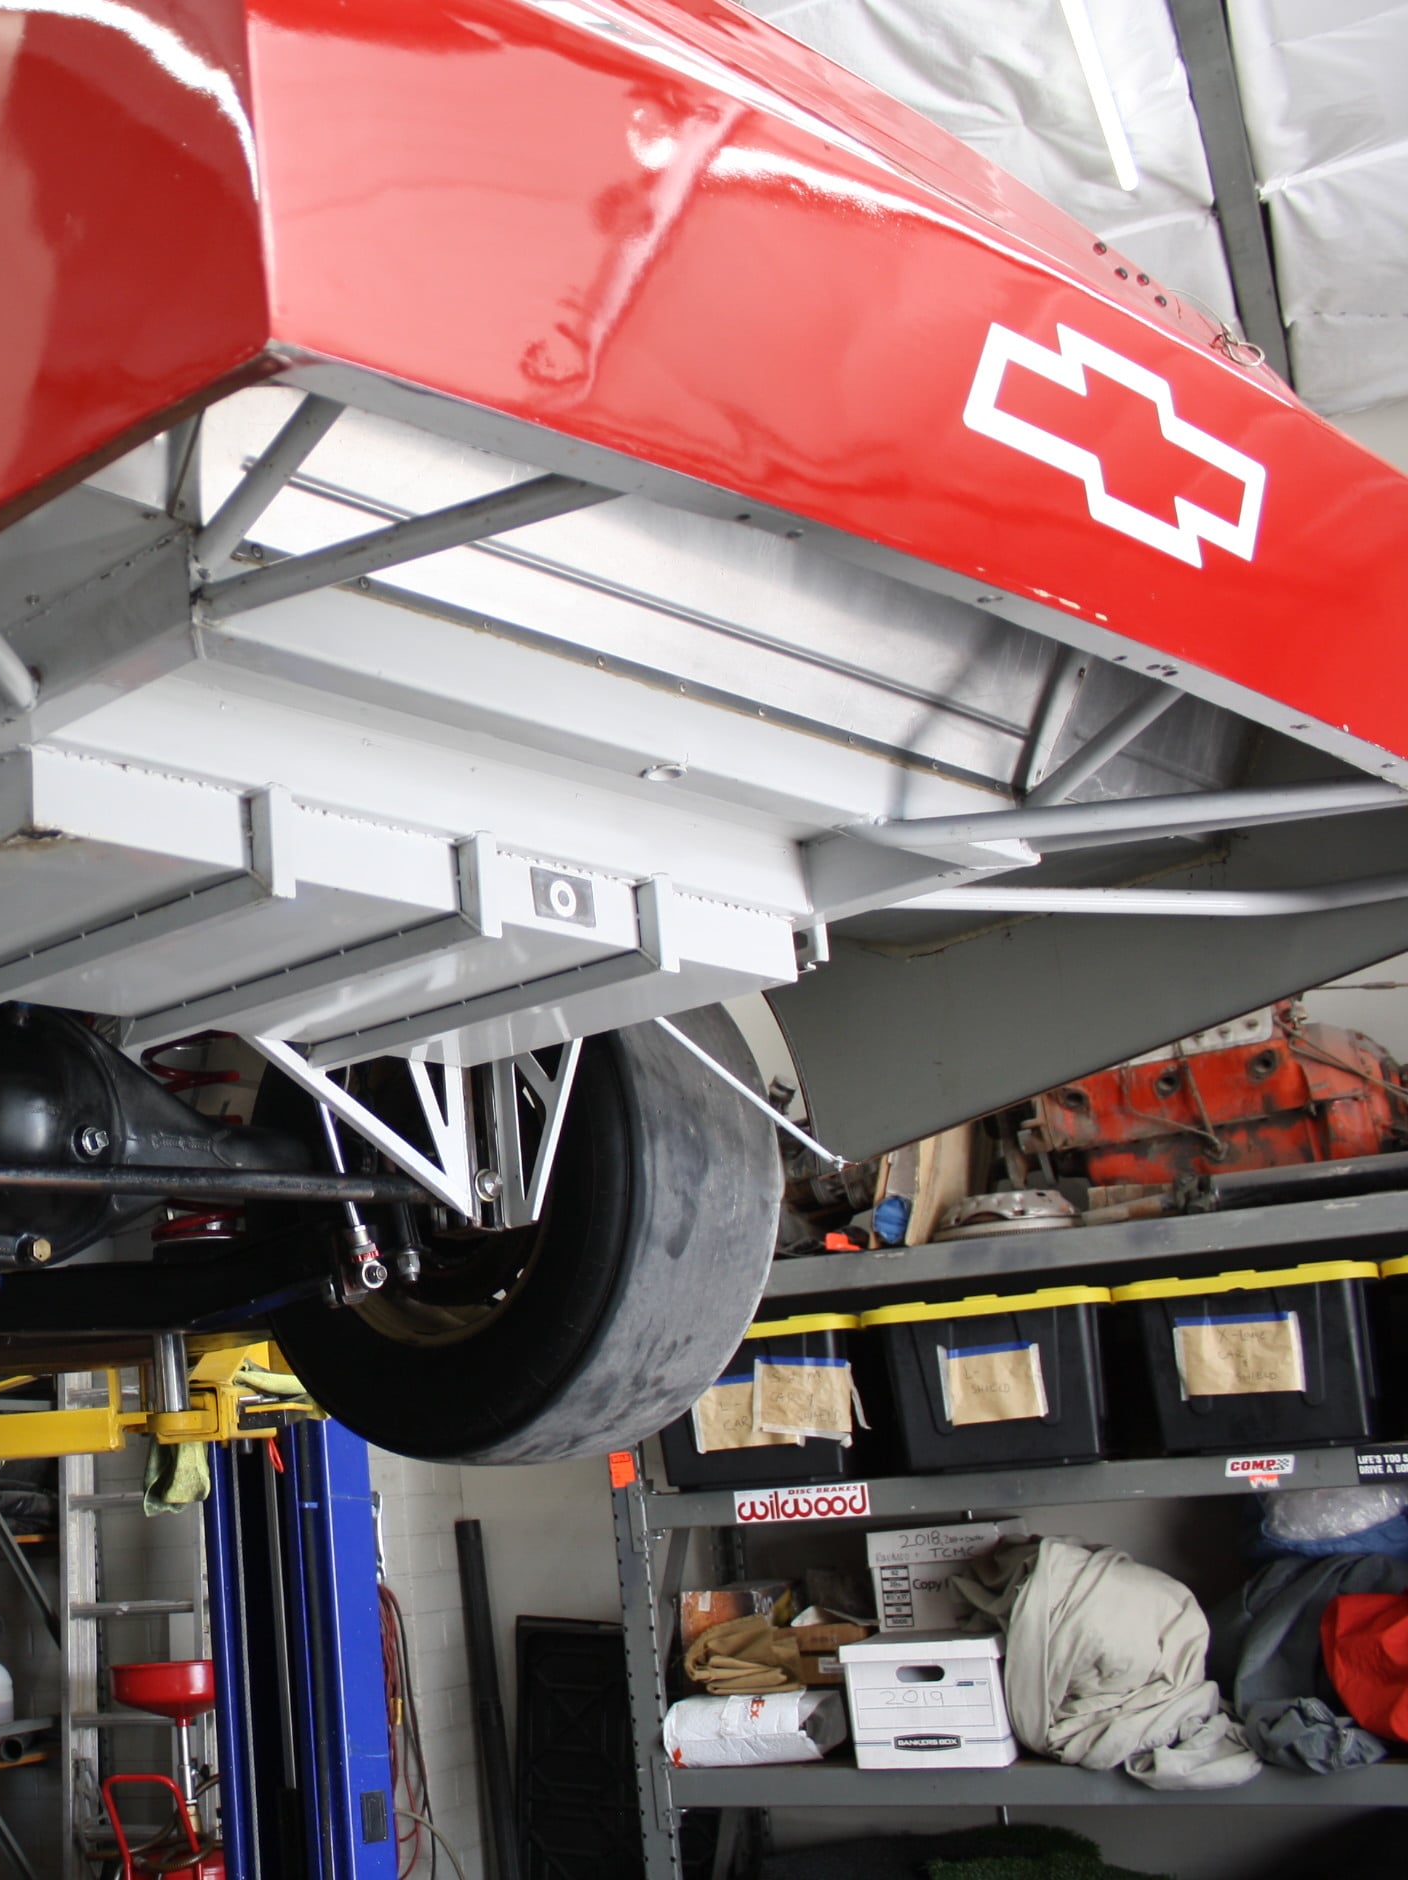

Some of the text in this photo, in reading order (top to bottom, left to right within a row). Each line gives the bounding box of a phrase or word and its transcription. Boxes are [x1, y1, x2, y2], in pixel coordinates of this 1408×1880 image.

[1383, 1453, 1401, 1463] TOO
[1230, 1459, 1277, 1472] COMP
[1358, 1465, 1384, 1475] DRIVE
[1386, 1465, 1394, 1474] A
[816, 1485, 858, 1493] BRAKES
[737, 1484, 867, 1521] wilwood
[912, 1578, 941, 1592] Copy
[880, 1690, 944, 1706] 2019
